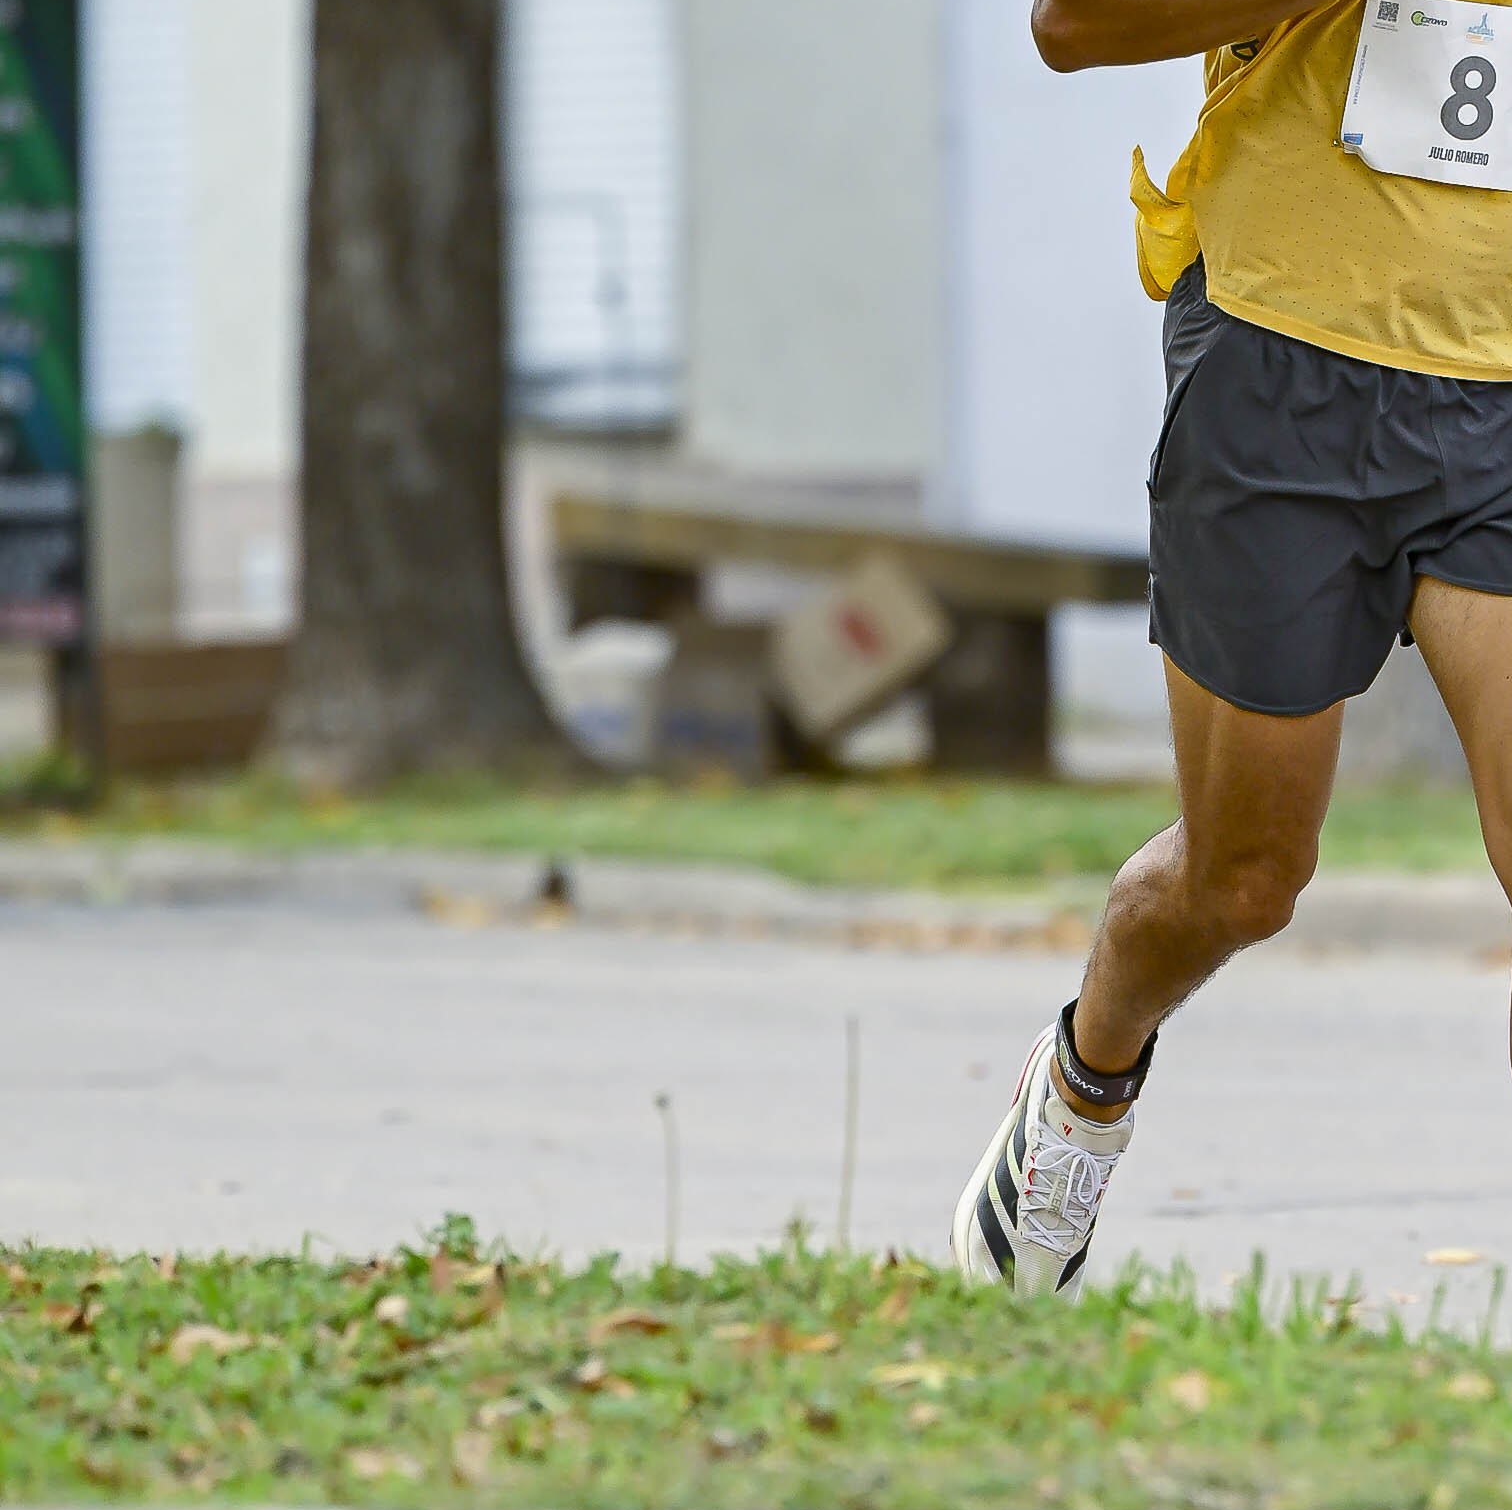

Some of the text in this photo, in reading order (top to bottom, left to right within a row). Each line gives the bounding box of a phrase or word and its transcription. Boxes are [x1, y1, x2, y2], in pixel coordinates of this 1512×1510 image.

[1441, 56, 1496, 140] 8
[1428, 147, 1489, 166] JULIO ROMERO
